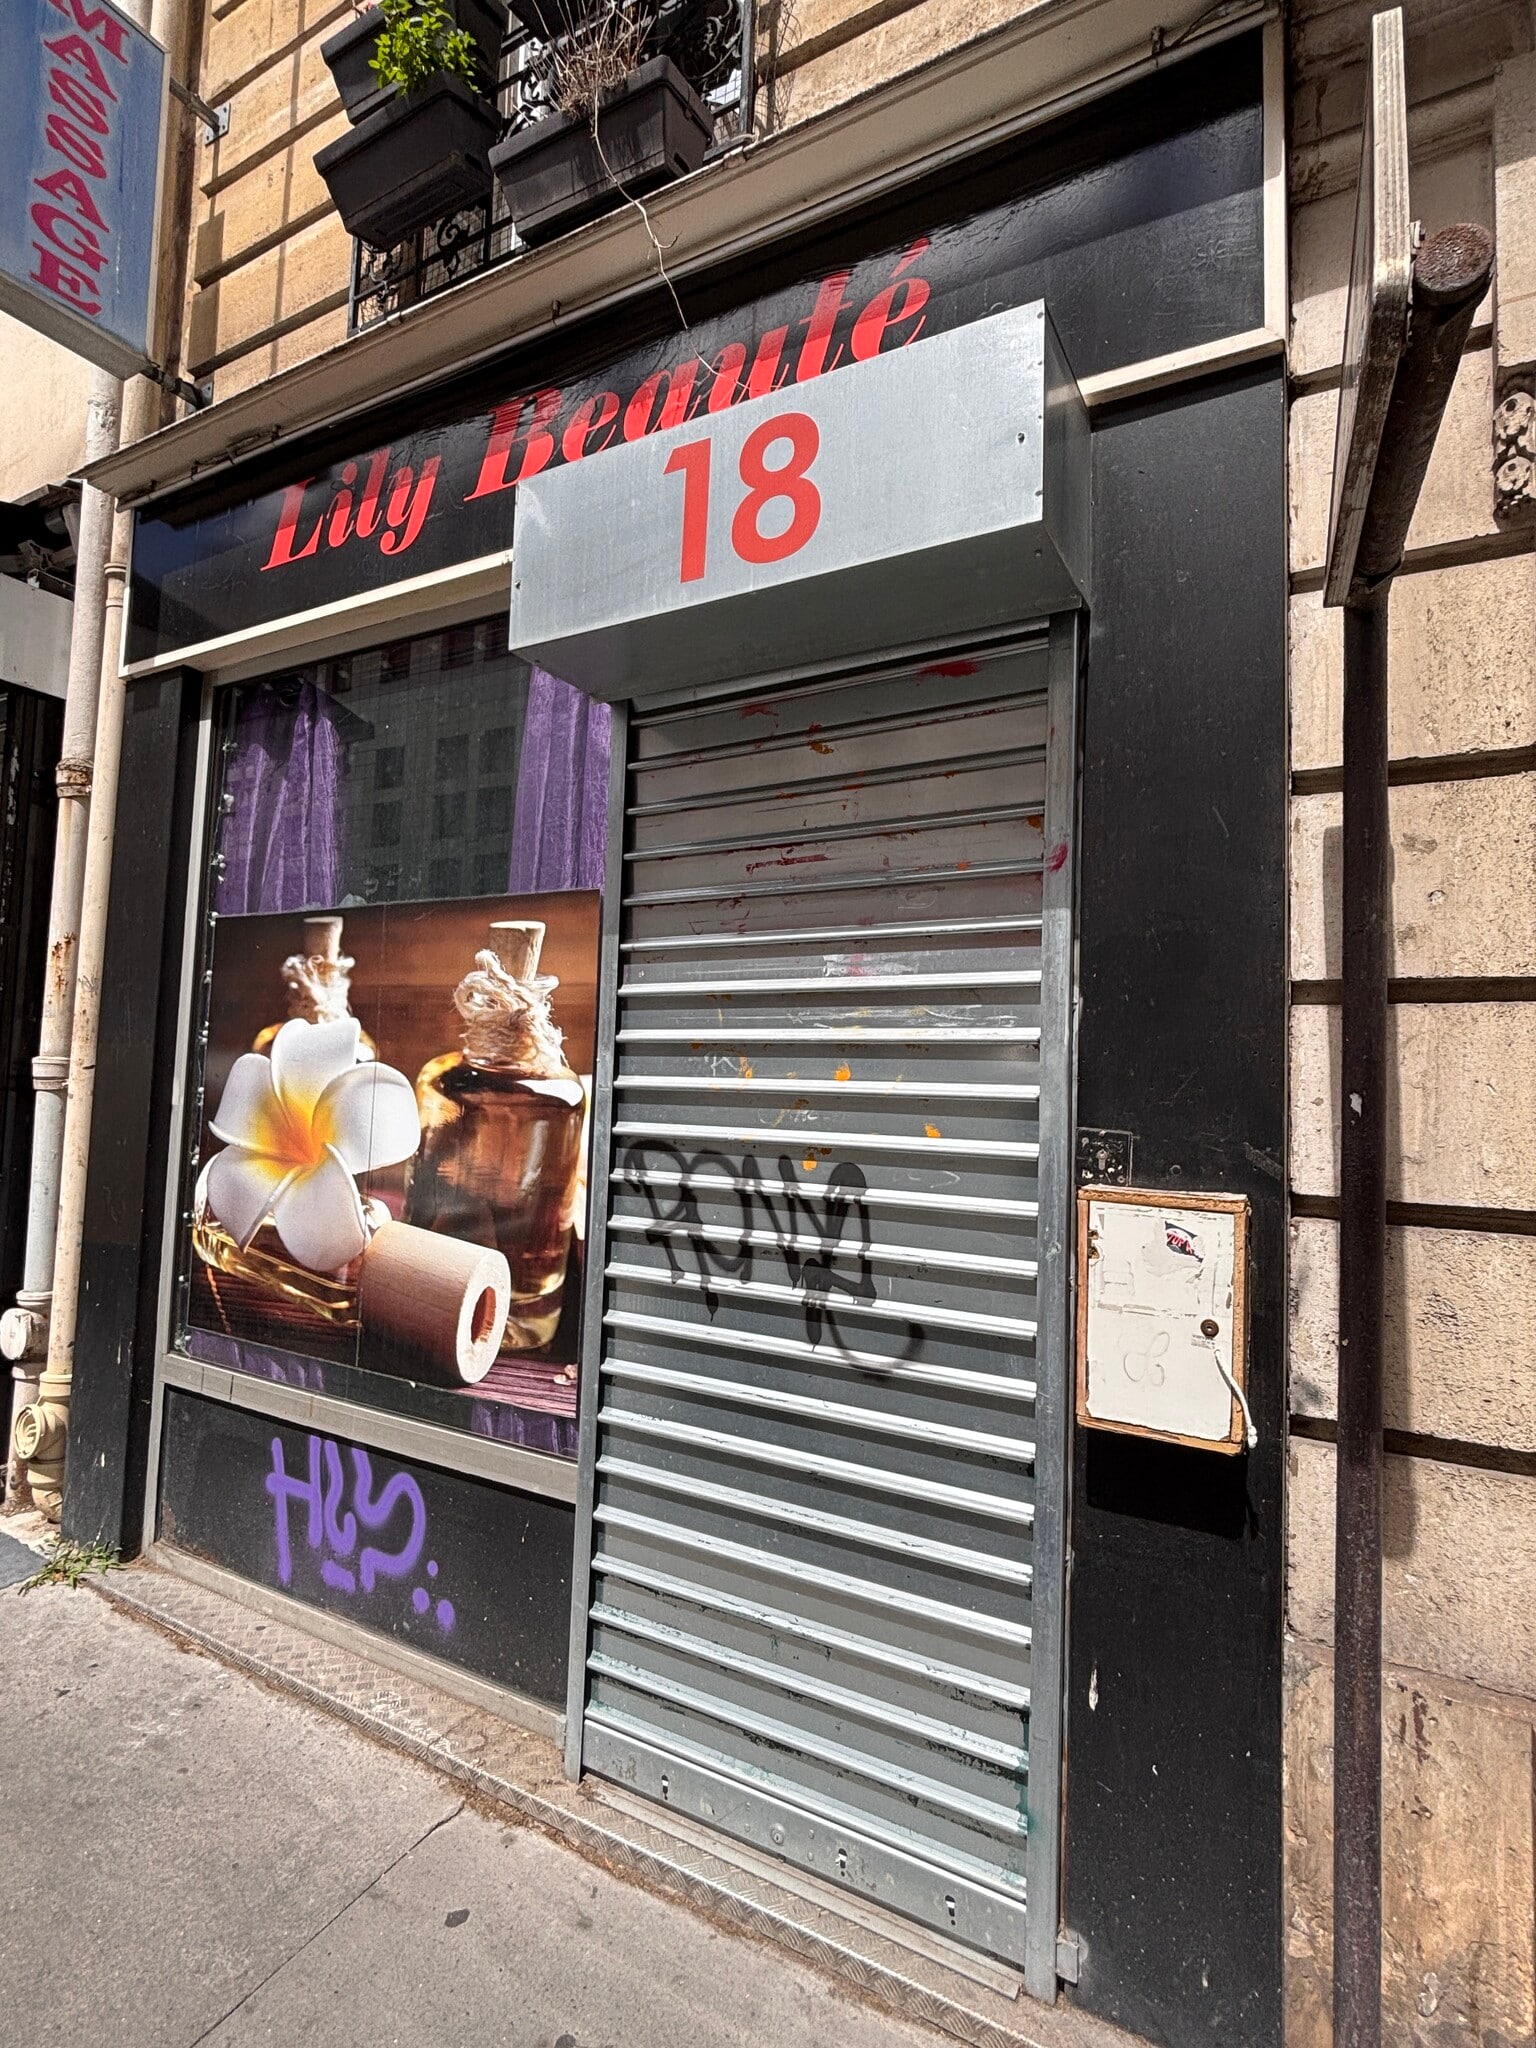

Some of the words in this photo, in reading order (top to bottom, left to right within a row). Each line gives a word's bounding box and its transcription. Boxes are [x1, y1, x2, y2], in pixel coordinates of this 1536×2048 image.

[260, 447, 442, 572] Lily
[463, 236, 932, 502] Beauté
[663, 412, 822, 585] 18
